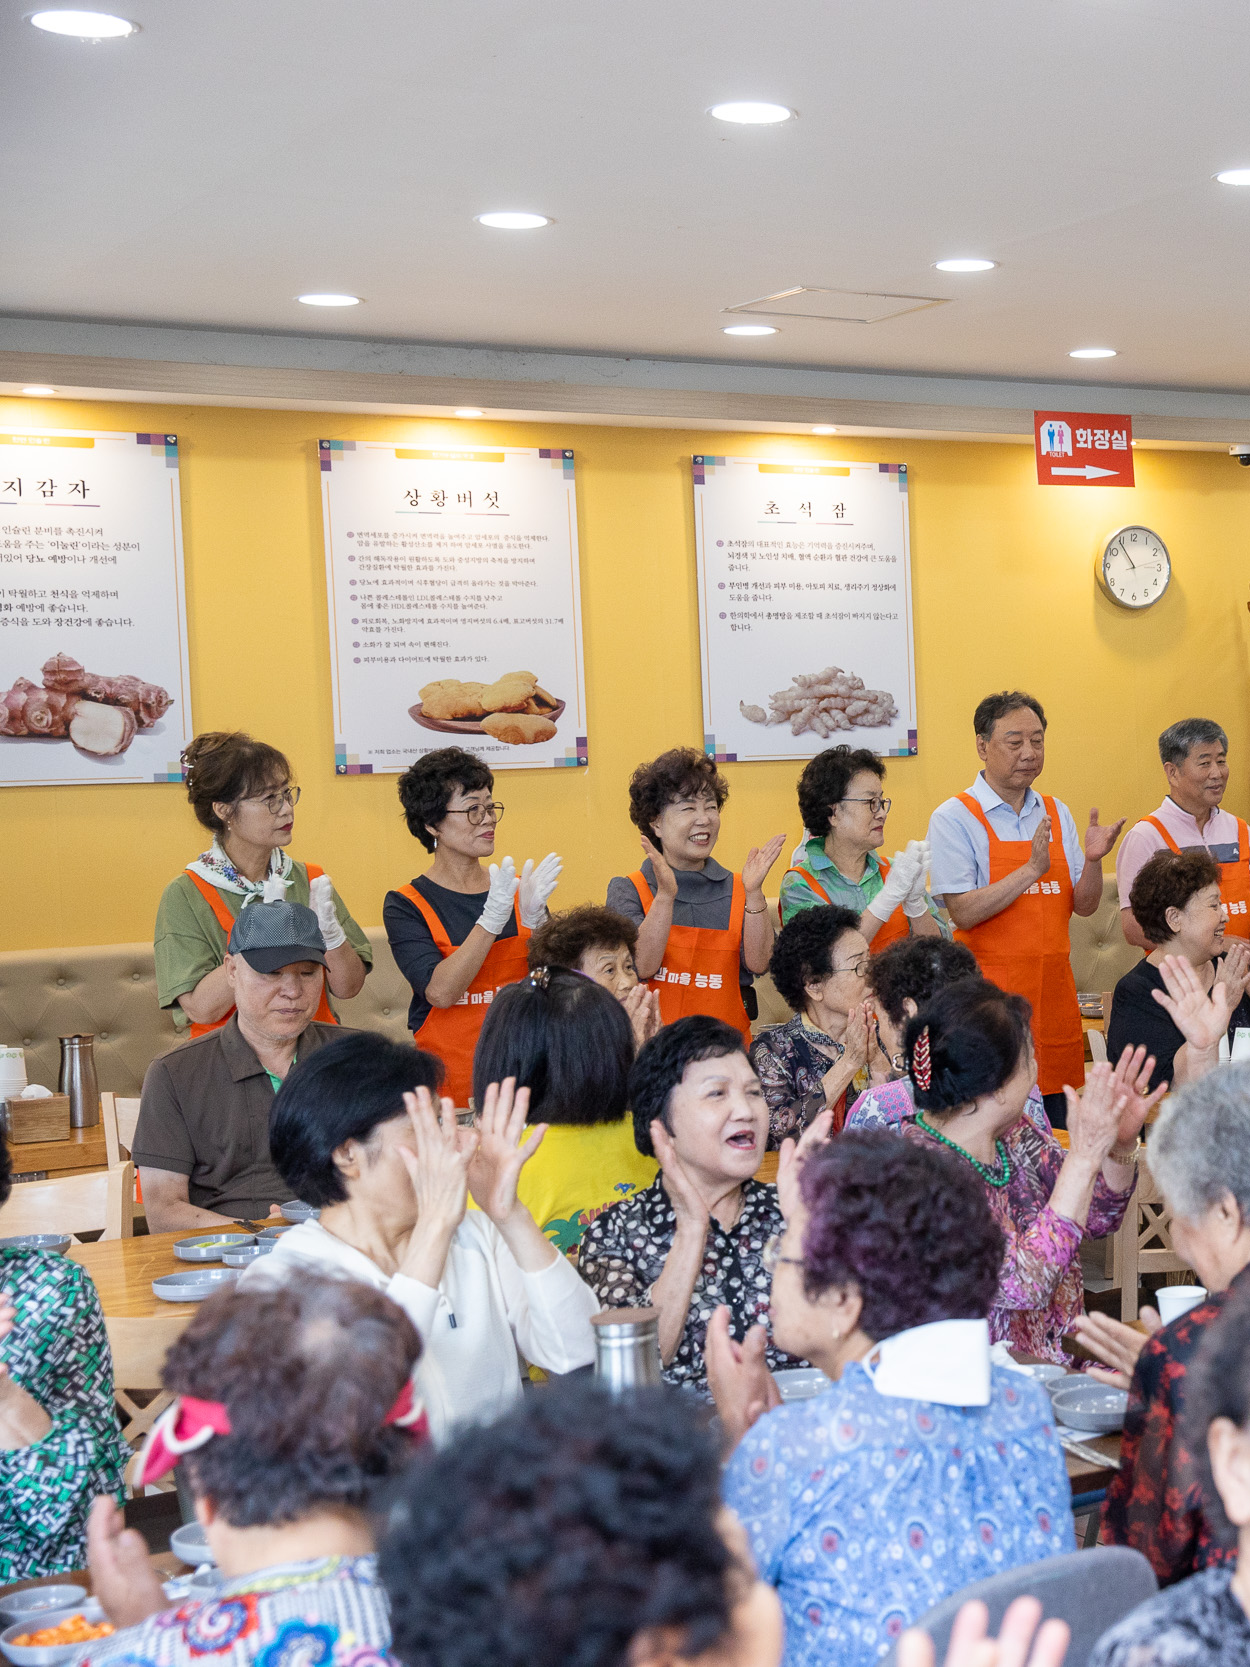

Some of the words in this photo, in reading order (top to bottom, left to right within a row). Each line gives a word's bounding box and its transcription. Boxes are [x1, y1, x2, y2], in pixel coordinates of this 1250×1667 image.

[1076, 428, 1128, 450] 화장실
[1131, 533, 1137, 542] 12
[1110, 548, 1118, 556] 10
[1153, 548, 1158, 556] 2
[1106, 563, 1110, 571] 9
[1157, 564, 1162, 572] 3
[1110, 578, 1115, 586] 8
[1144, 589, 1148, 597] 5
[730, 624, 753, 632] 합니다.
[695, 973, 722, 989] 능동
